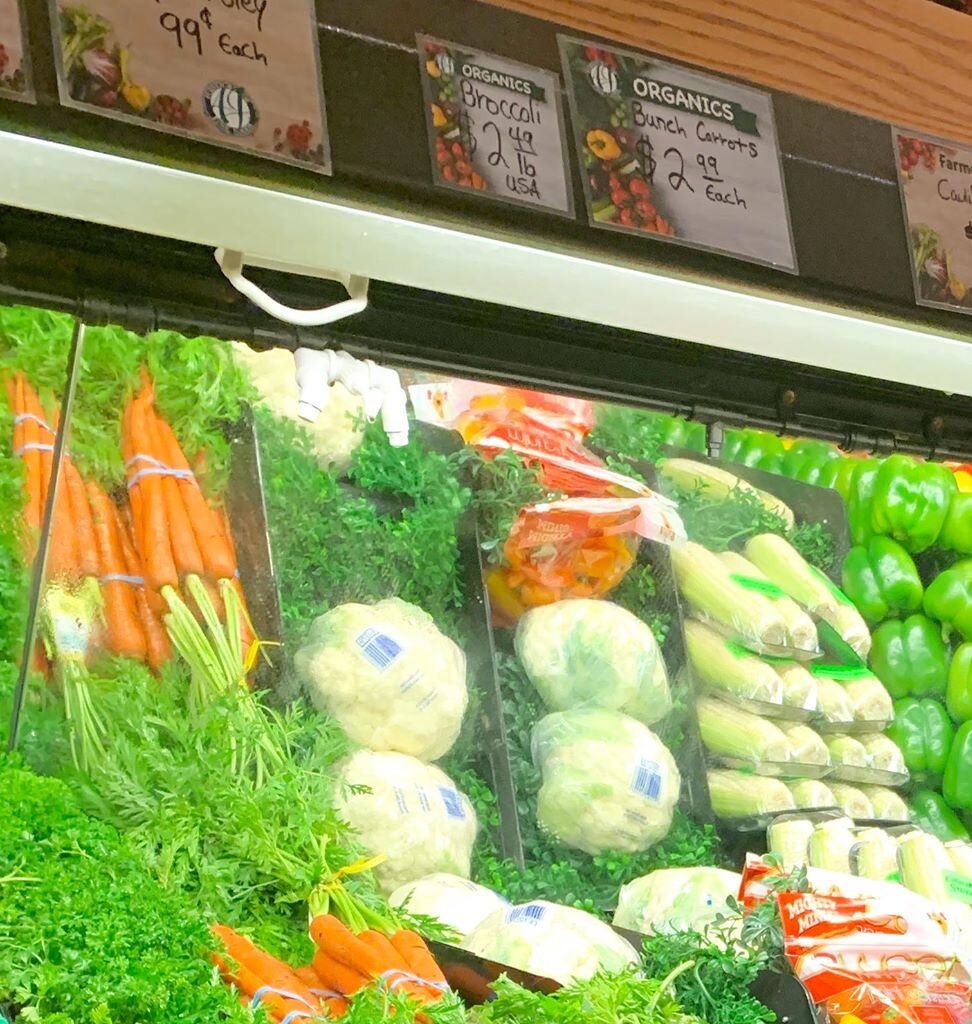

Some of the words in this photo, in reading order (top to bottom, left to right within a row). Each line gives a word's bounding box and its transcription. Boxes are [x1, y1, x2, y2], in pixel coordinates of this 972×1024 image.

[218, 33, 268, 65] Each
[462, 64, 532, 94] ORGANICS
[460, 79, 541, 124] Broccoli
[633, 78, 734, 121] ORGANICS
[632, 101, 687, 138] Bunch
[696, 121, 758, 158] Carrots
[505, 174, 540, 199] USA
[705, 184, 747, 209] Each
